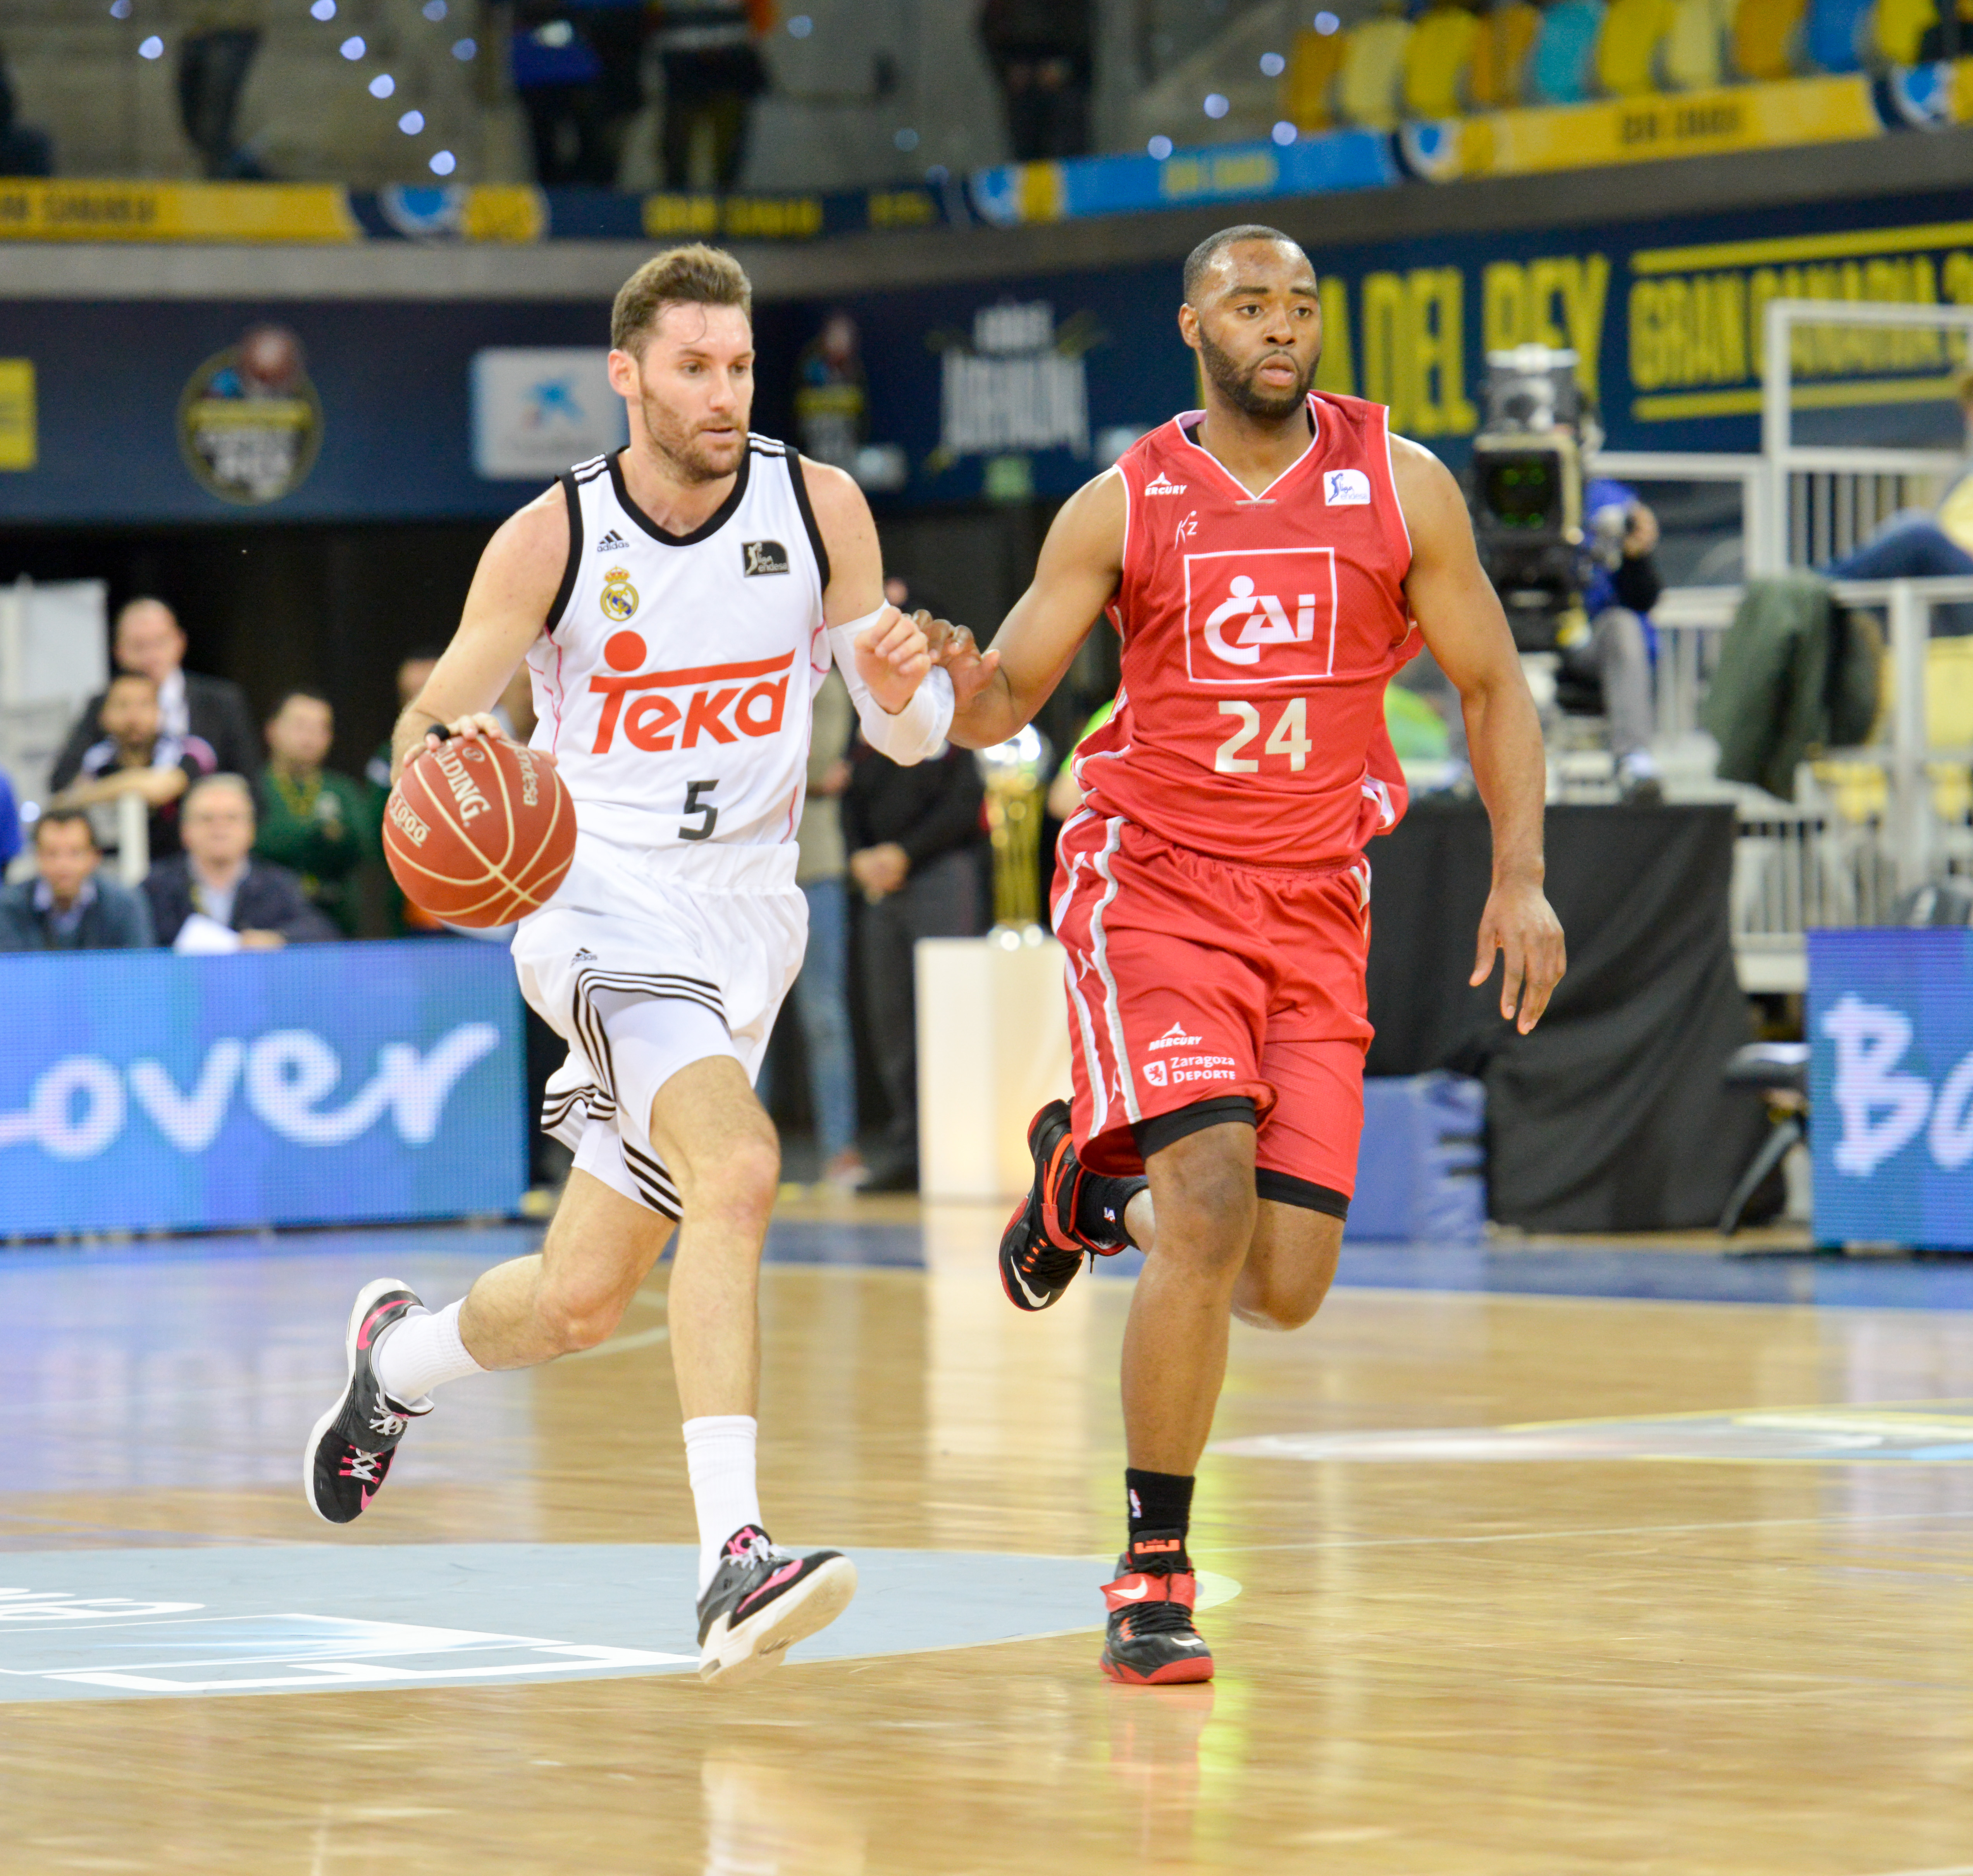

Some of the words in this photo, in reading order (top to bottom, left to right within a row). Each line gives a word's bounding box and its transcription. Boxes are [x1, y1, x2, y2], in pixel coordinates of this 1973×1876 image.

[1145, 485, 1187, 496] ERCURY
[597, 541, 630, 552] adidas
[1215, 697, 1312, 773] 24
[678, 779, 720, 840] 5
[1148, 1036, 1202, 1051] MERCURY
[1170, 1056, 1235, 1069] Zaragoza
